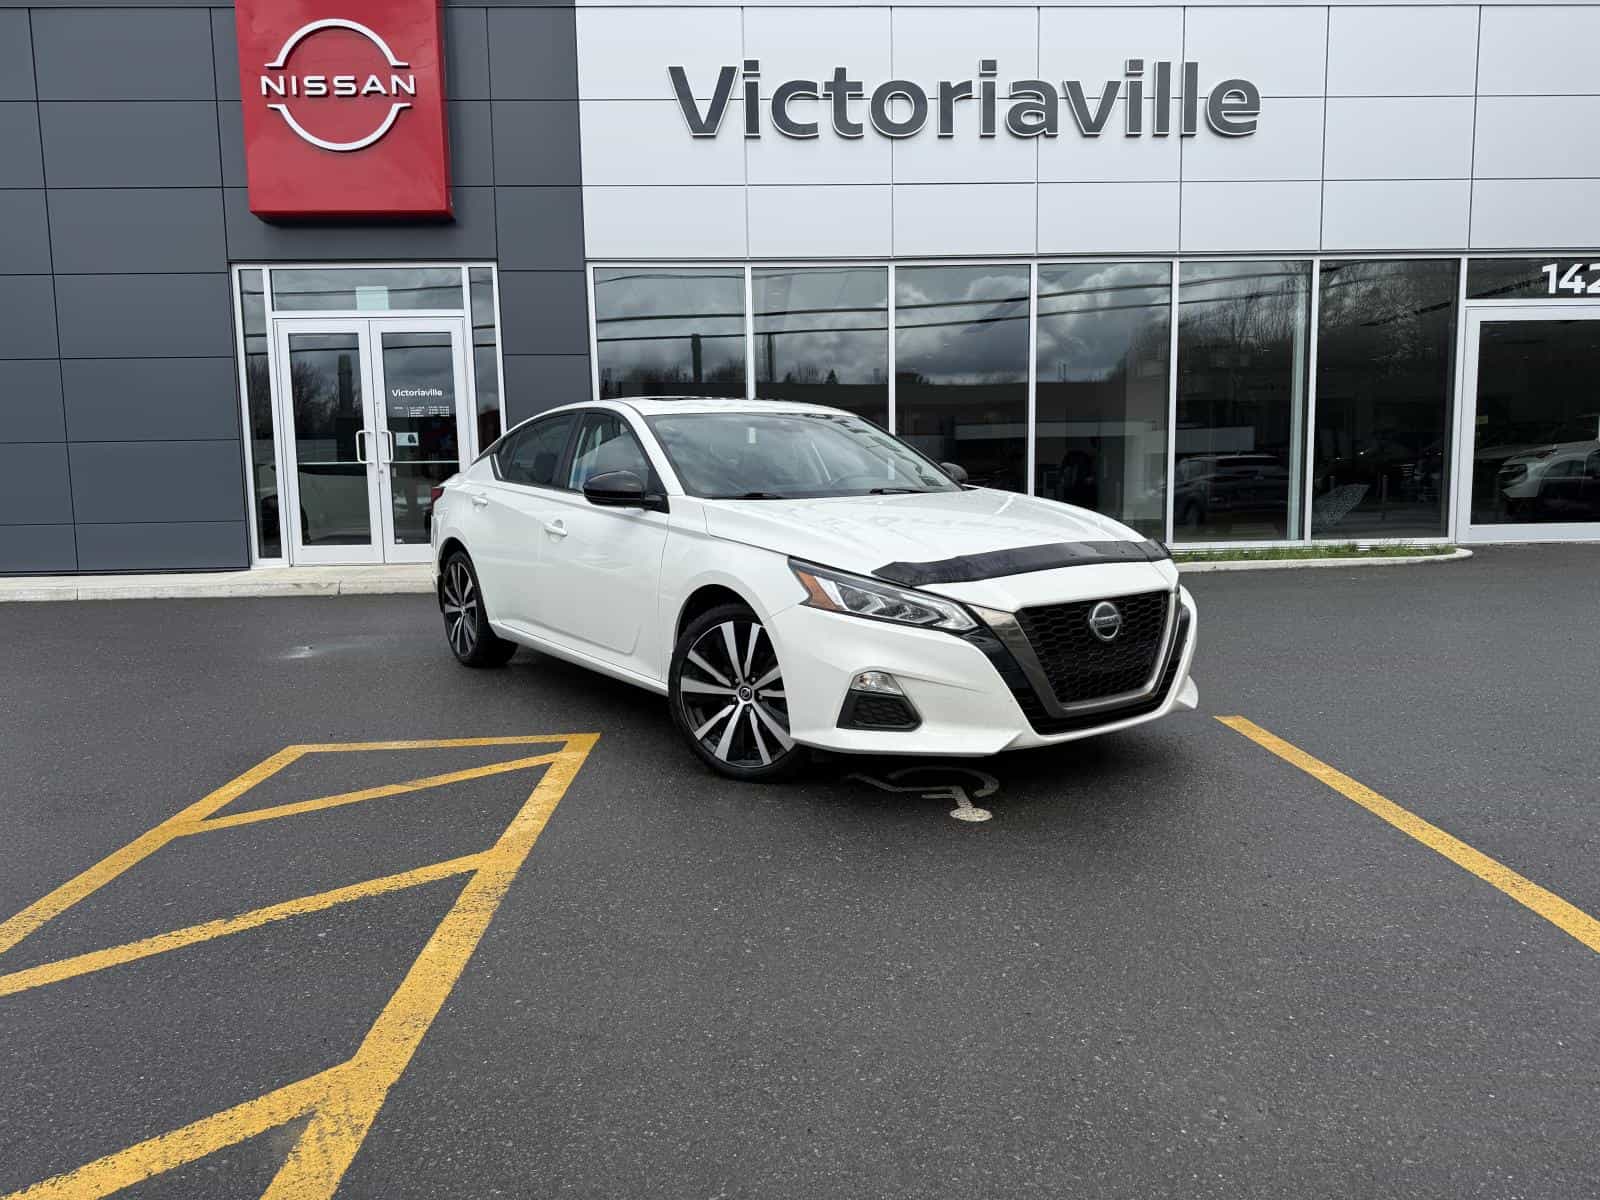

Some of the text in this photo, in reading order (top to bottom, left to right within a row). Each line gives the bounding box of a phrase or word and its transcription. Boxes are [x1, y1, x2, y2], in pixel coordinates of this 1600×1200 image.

[260, 74, 416, 96] NISSAN
[666, 58, 1262, 138] Victoriaville
[391, 388, 443, 397] Victoriaville
